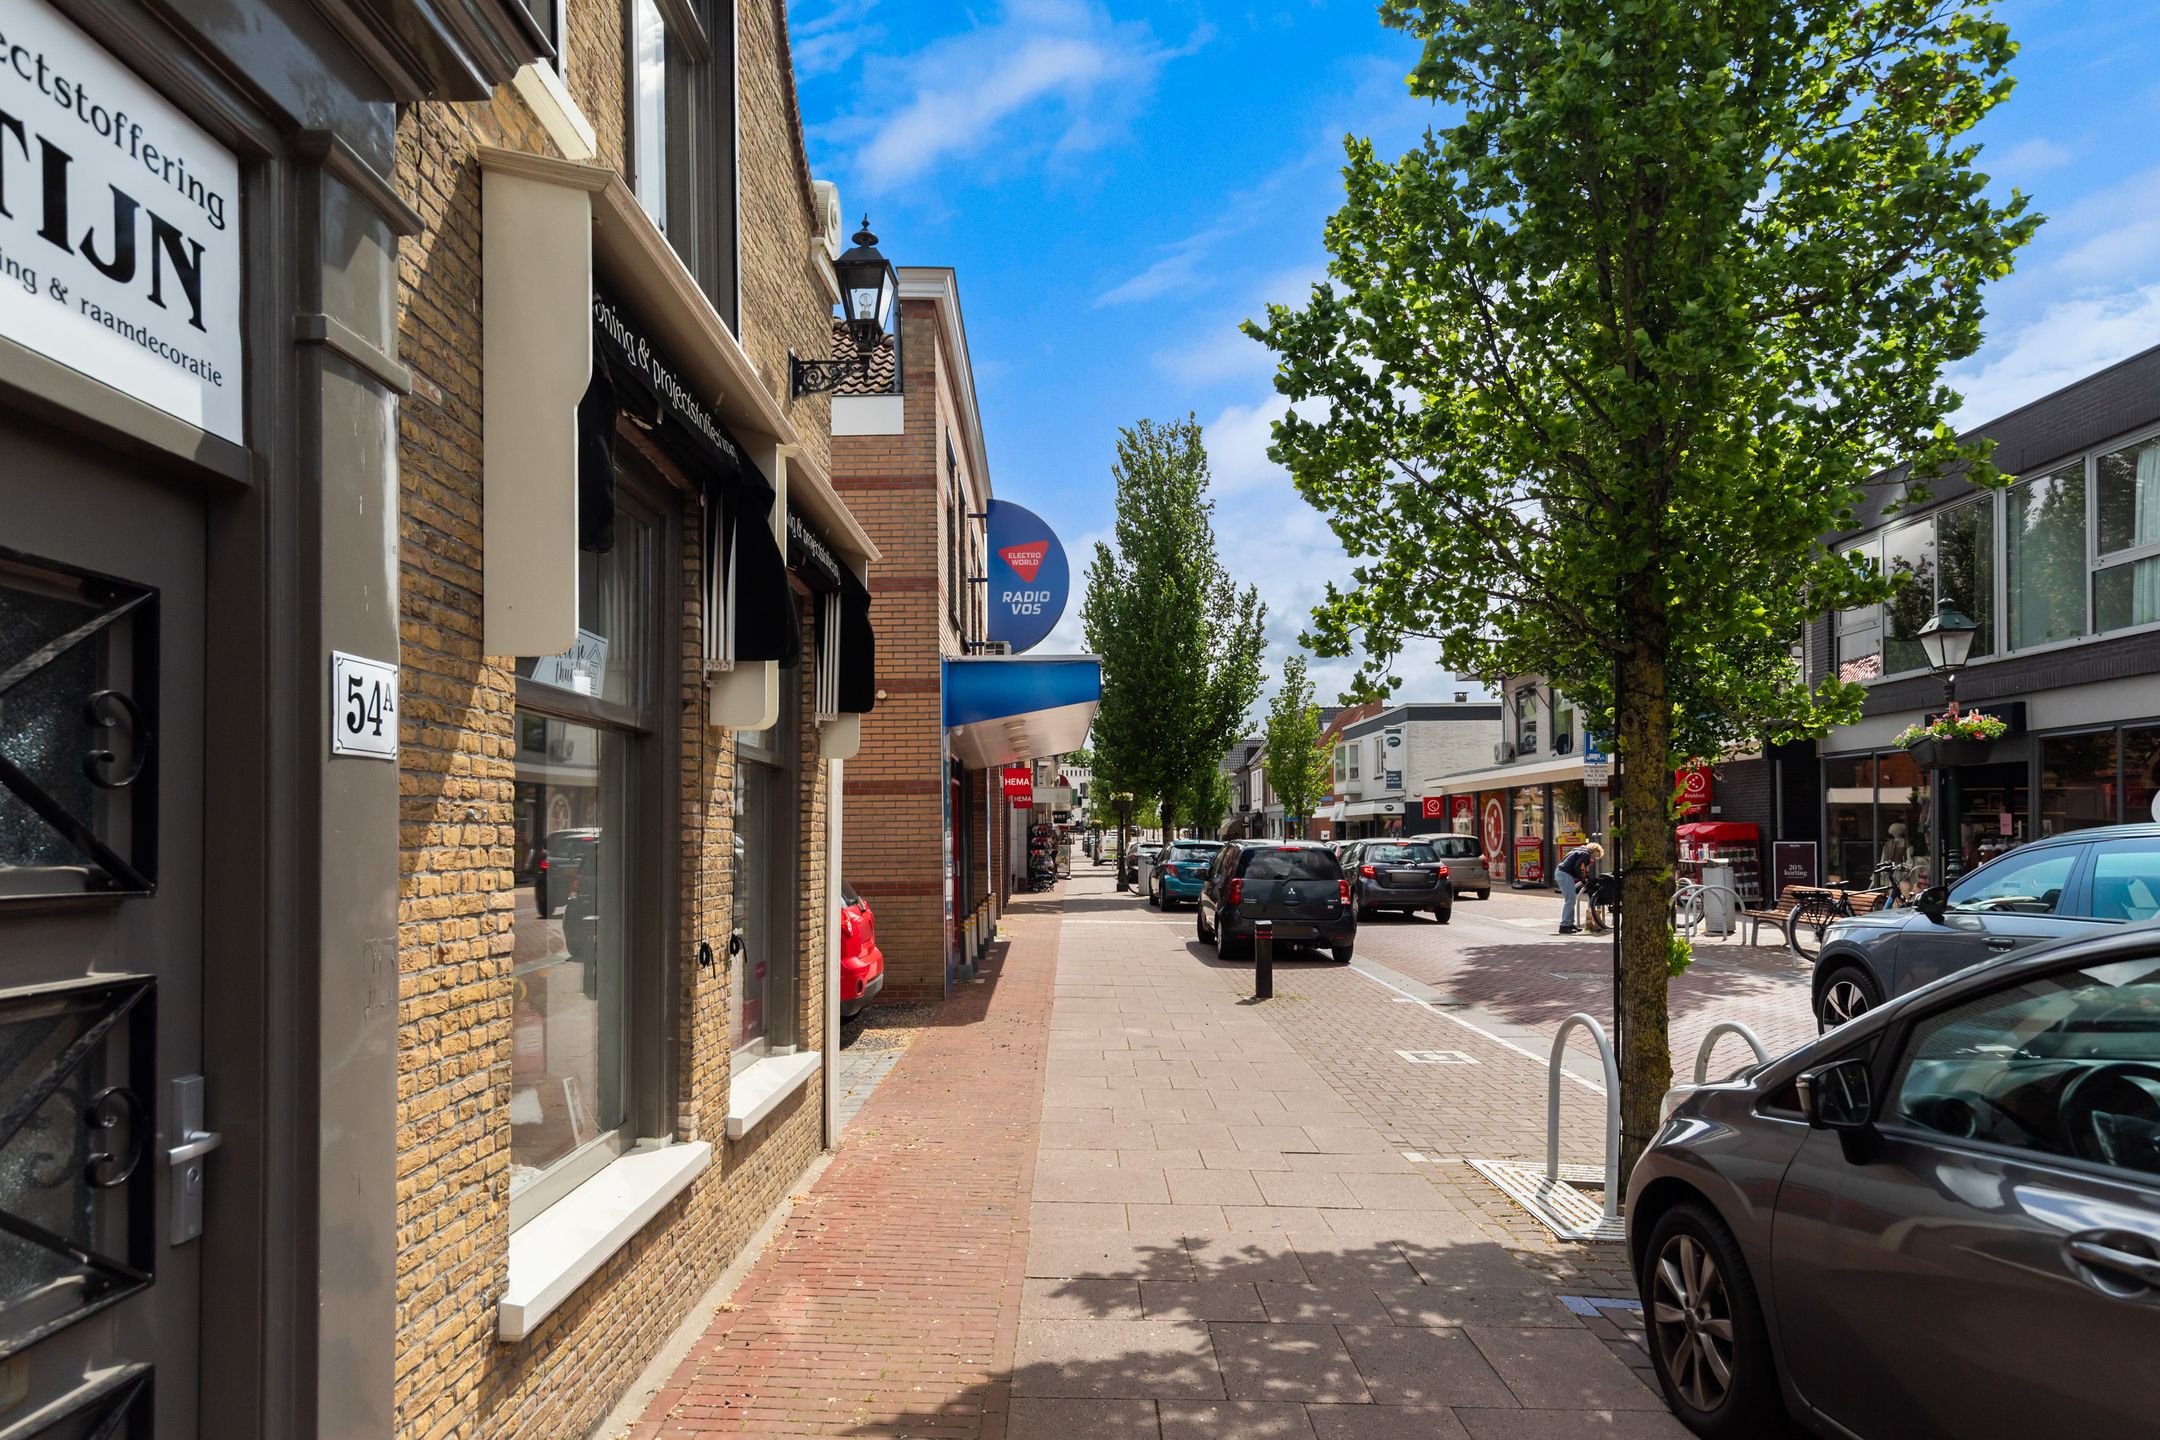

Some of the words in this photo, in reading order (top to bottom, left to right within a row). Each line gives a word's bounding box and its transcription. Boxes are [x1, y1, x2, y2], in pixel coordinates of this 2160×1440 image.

[49, 277, 68, 305] &
[80, 297, 222, 387] raamdecoratie
[638, 337, 650, 374] &
[1002, 591, 1051, 603] RADIO
[1011, 603, 1042, 615] VOS
[554, 660, 577, 684] thui
[1004, 778, 1030, 786] HEMA
[1014, 795, 1032, 803] HEMA
[1784, 869, 1808, 877] korting
